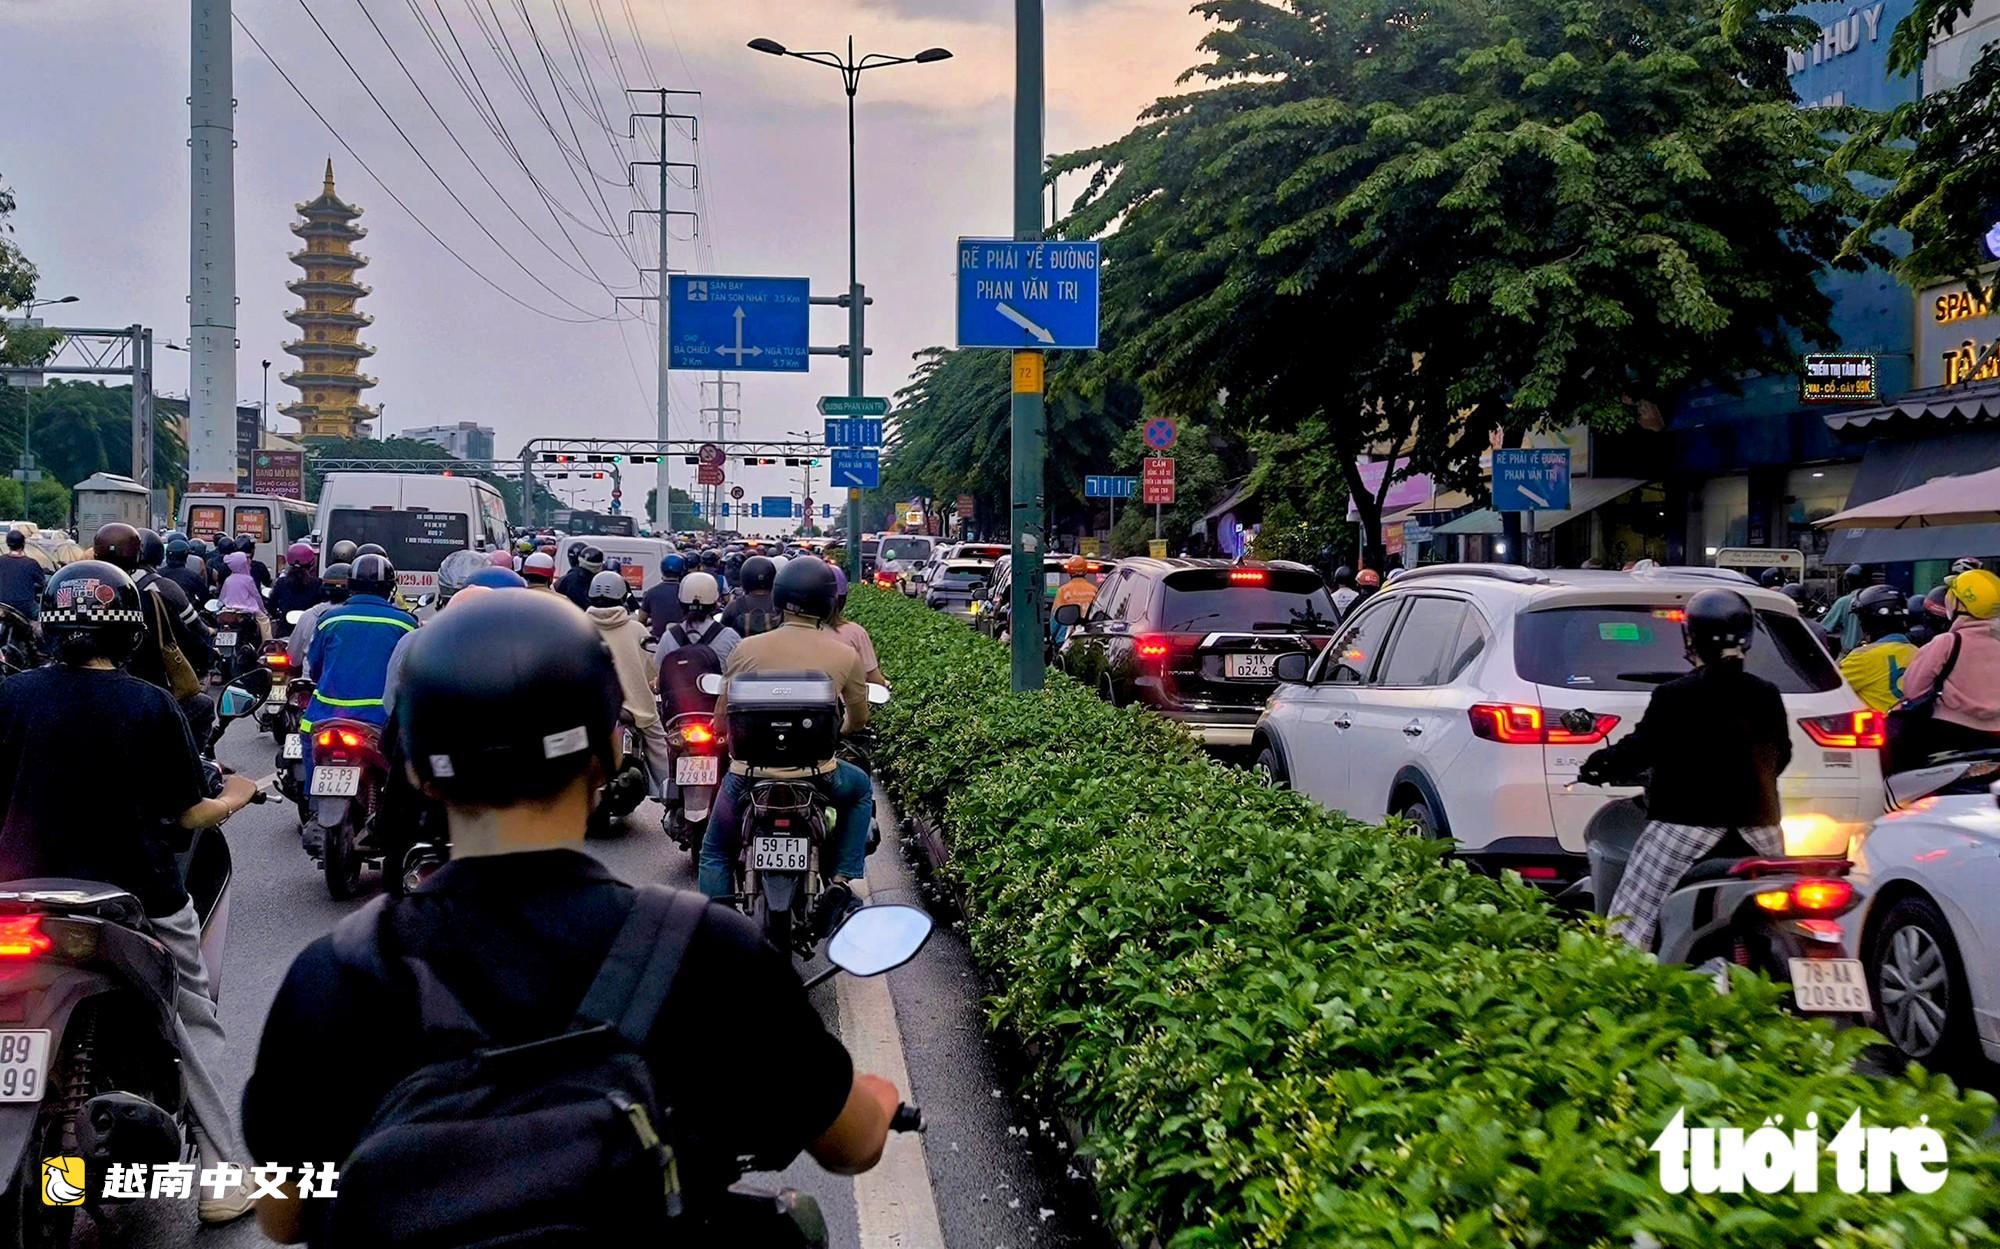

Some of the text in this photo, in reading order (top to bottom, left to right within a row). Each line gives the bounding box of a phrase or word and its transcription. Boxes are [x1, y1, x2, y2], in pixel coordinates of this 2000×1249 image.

[962, 246, 979, 269] RẼ
[986, 245, 1018, 269] PHẢI
[1050, 246, 1095, 269] ĐƯỜNG
[977, 276, 1078, 303] PHAN VĂN TRỊ
[1936, 291, 1972, 321] SPA
[1019, 367, 1031, 378] 72
[1505, 469, 1525, 480] PHAN
[1246, 656, 1265, 665] 51K
[683, 759, 710, 770] 72-AA
[320, 769, 352, 781] 55-P3
[319, 781, 351, 794] 8447
[756, 853, 806, 867] 845.68
